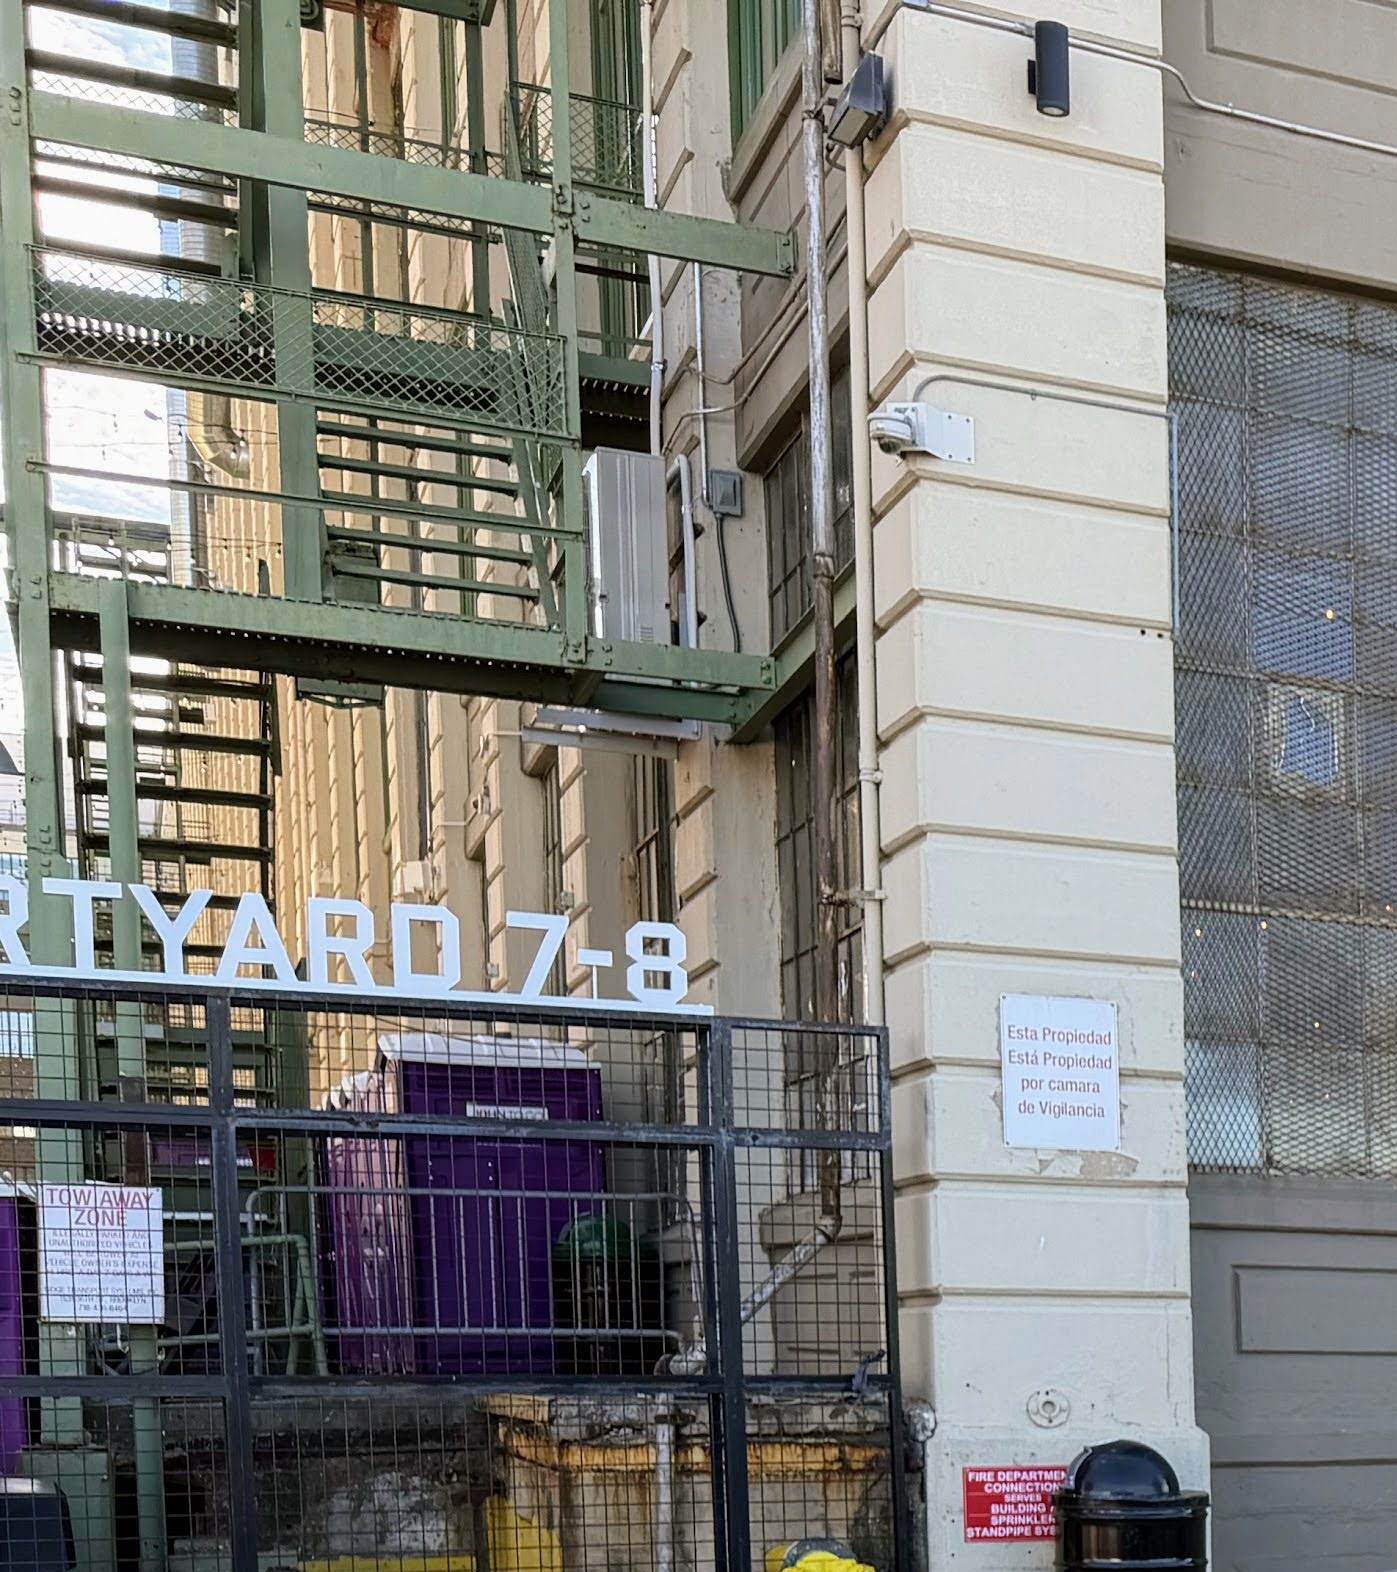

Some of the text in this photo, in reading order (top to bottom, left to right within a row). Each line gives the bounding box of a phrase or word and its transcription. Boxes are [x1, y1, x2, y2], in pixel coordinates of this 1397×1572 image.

[505, 910, 688, 1004] 7-8
[1007, 1024, 1112, 1046] Esta Propiedad
[1008, 1049, 1112, 1070] Está Propiedad
[1020, 1077, 1100, 1093] por camara
[1018, 1099, 1105, 1119] de Vigilancia
[46, 1188, 153, 1209] TOW AWAY
[74, 1208, 128, 1227] ZONE
[968, 1471, 995, 1482] FIRE
[984, 1482, 1060, 1493] CONNECTION
[1004, 1493, 1042, 1503] SERVES
[991, 1503, 1046, 1514] BUILDING
[966, 1525, 1032, 1538] STANDPIPE
